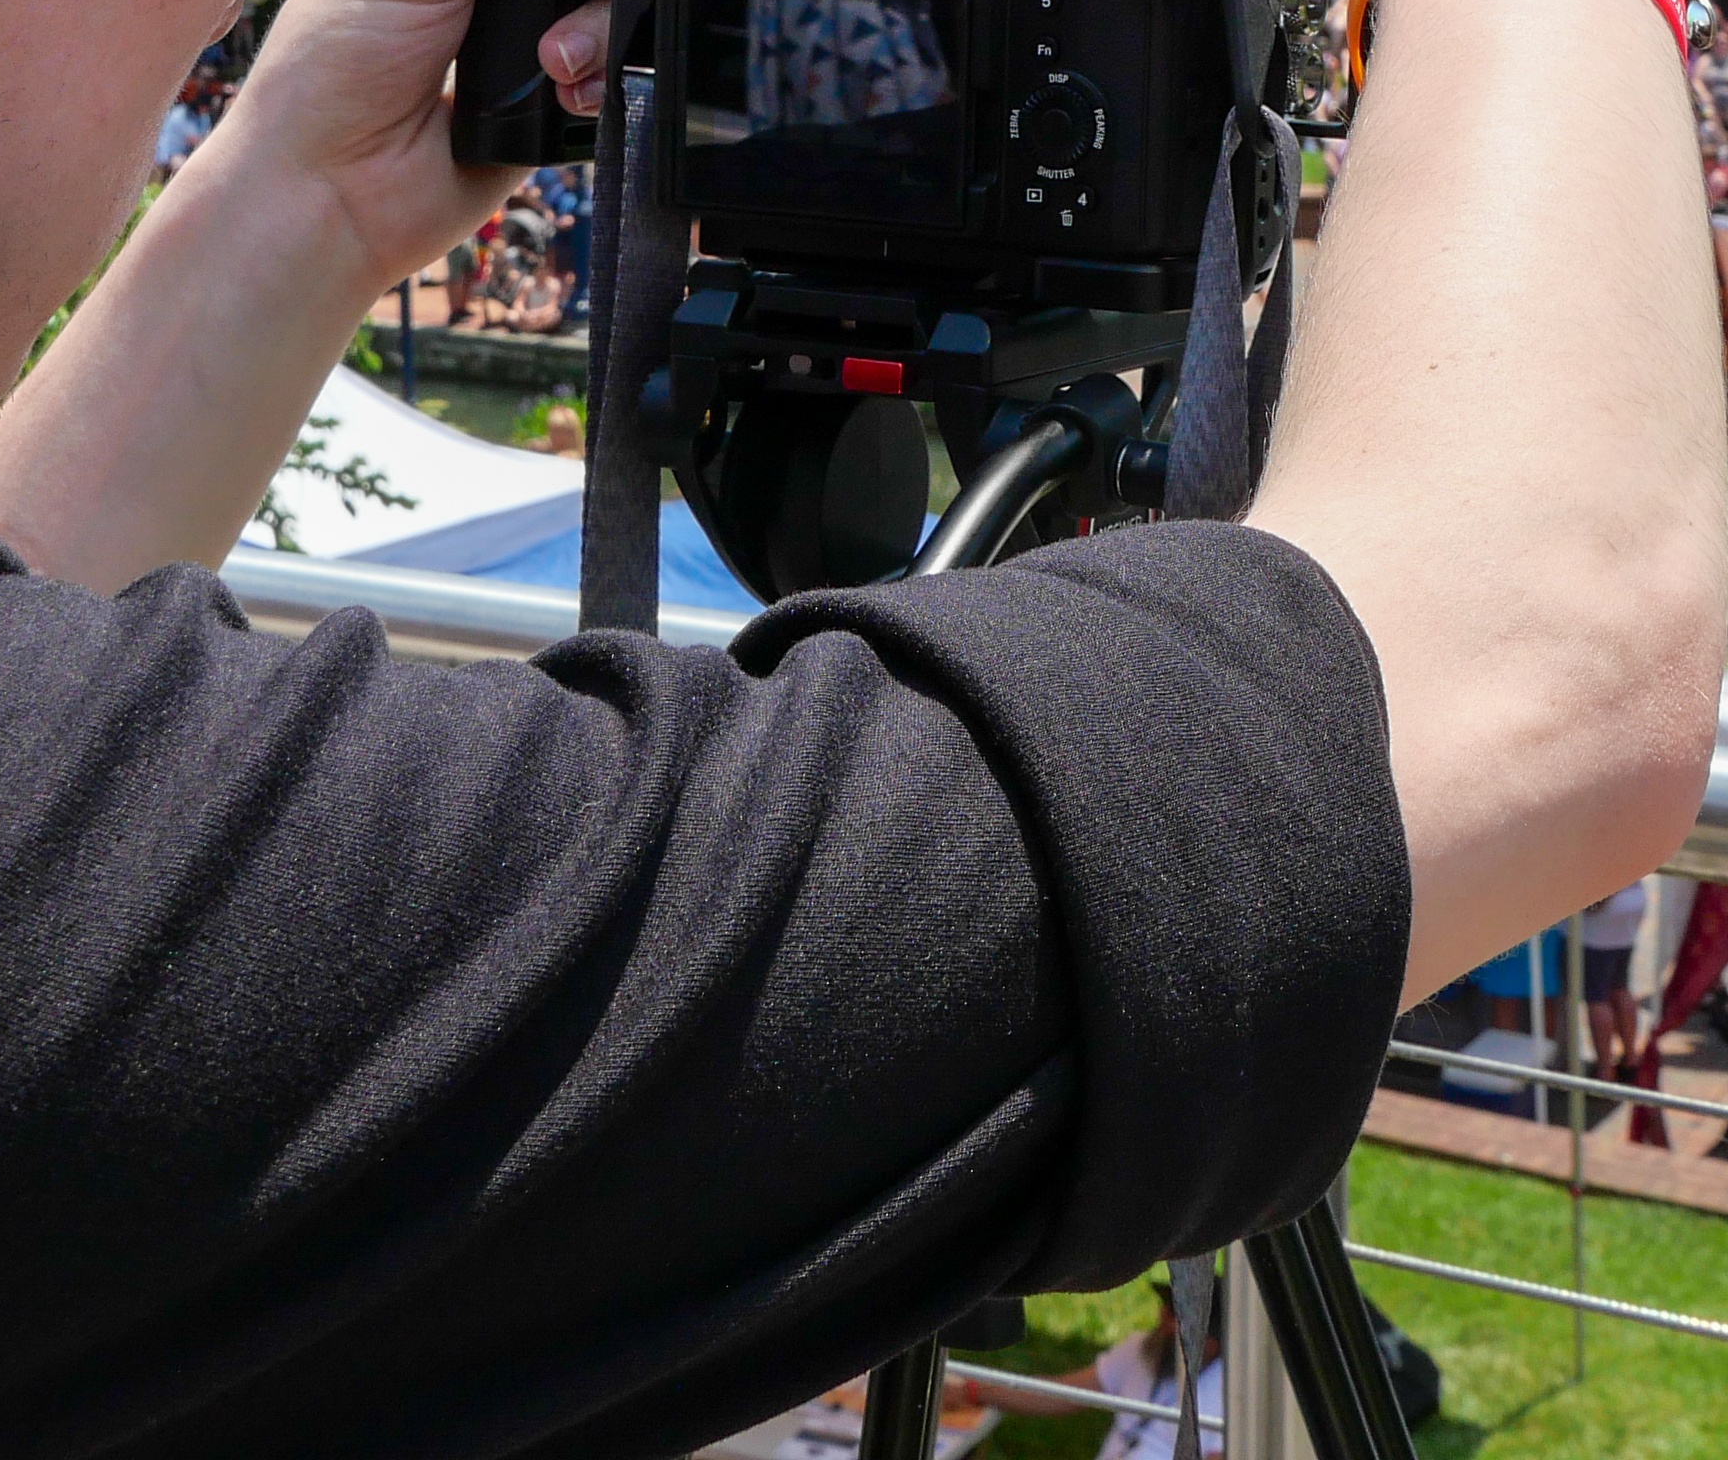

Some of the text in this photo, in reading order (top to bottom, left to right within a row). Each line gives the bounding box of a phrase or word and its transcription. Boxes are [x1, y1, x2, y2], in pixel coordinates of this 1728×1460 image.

[1037, 44, 1052, 56] Fn
[1048, 73, 1069, 84] DISP
[1009, 108, 1021, 139] ZEBRA
[1092, 108, 1106, 150] PEAKING
[1036, 165, 1076, 179] SHUTTER
[1077, 192, 1088, 207] 4
